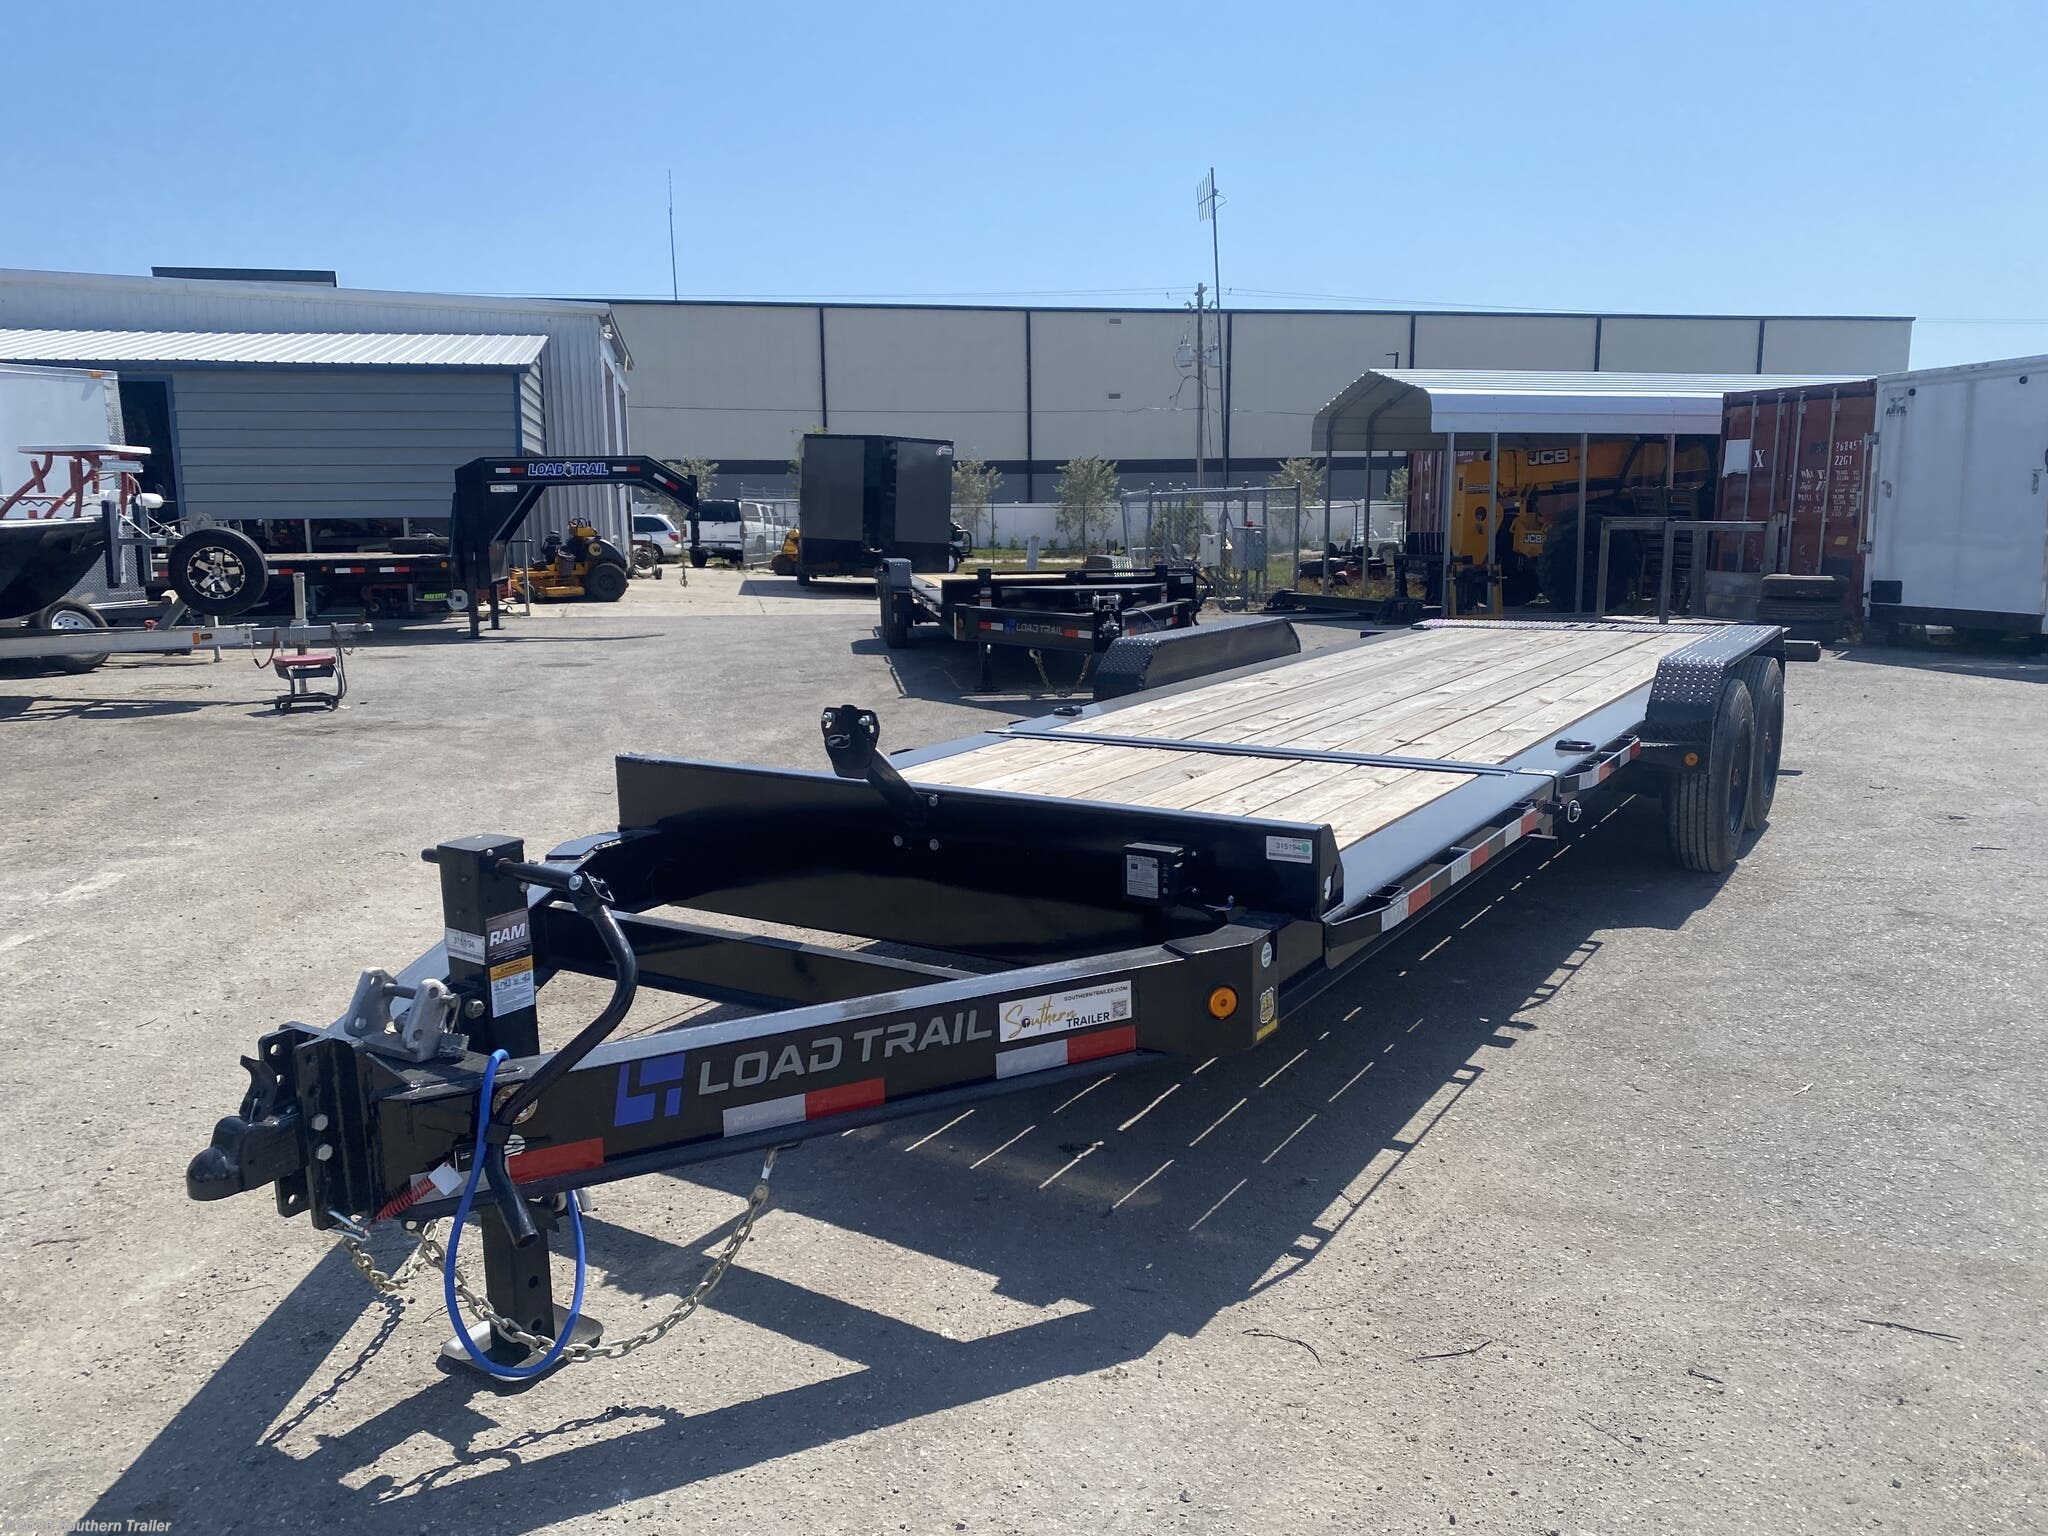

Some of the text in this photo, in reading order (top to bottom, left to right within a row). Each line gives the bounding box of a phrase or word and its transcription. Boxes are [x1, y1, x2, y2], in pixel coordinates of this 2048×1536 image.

[1528, 449, 1569, 465] JCB
[528, 462, 609, 476] LOAD TRAIL
[1524, 534, 1542, 543] JCB
[1016, 623, 1039, 633] LOAD
[1039, 625, 1063, 635] TRAIL
[489, 923, 526, 947] RAM
[1063, 985, 1128, 1002] SOUTHERNTRAILER.COM
[1004, 996, 1077, 1039] Southern
[1066, 1012, 1110, 1028] TRAILER
[698, 1010, 993, 1096] LOAD TRAIL
